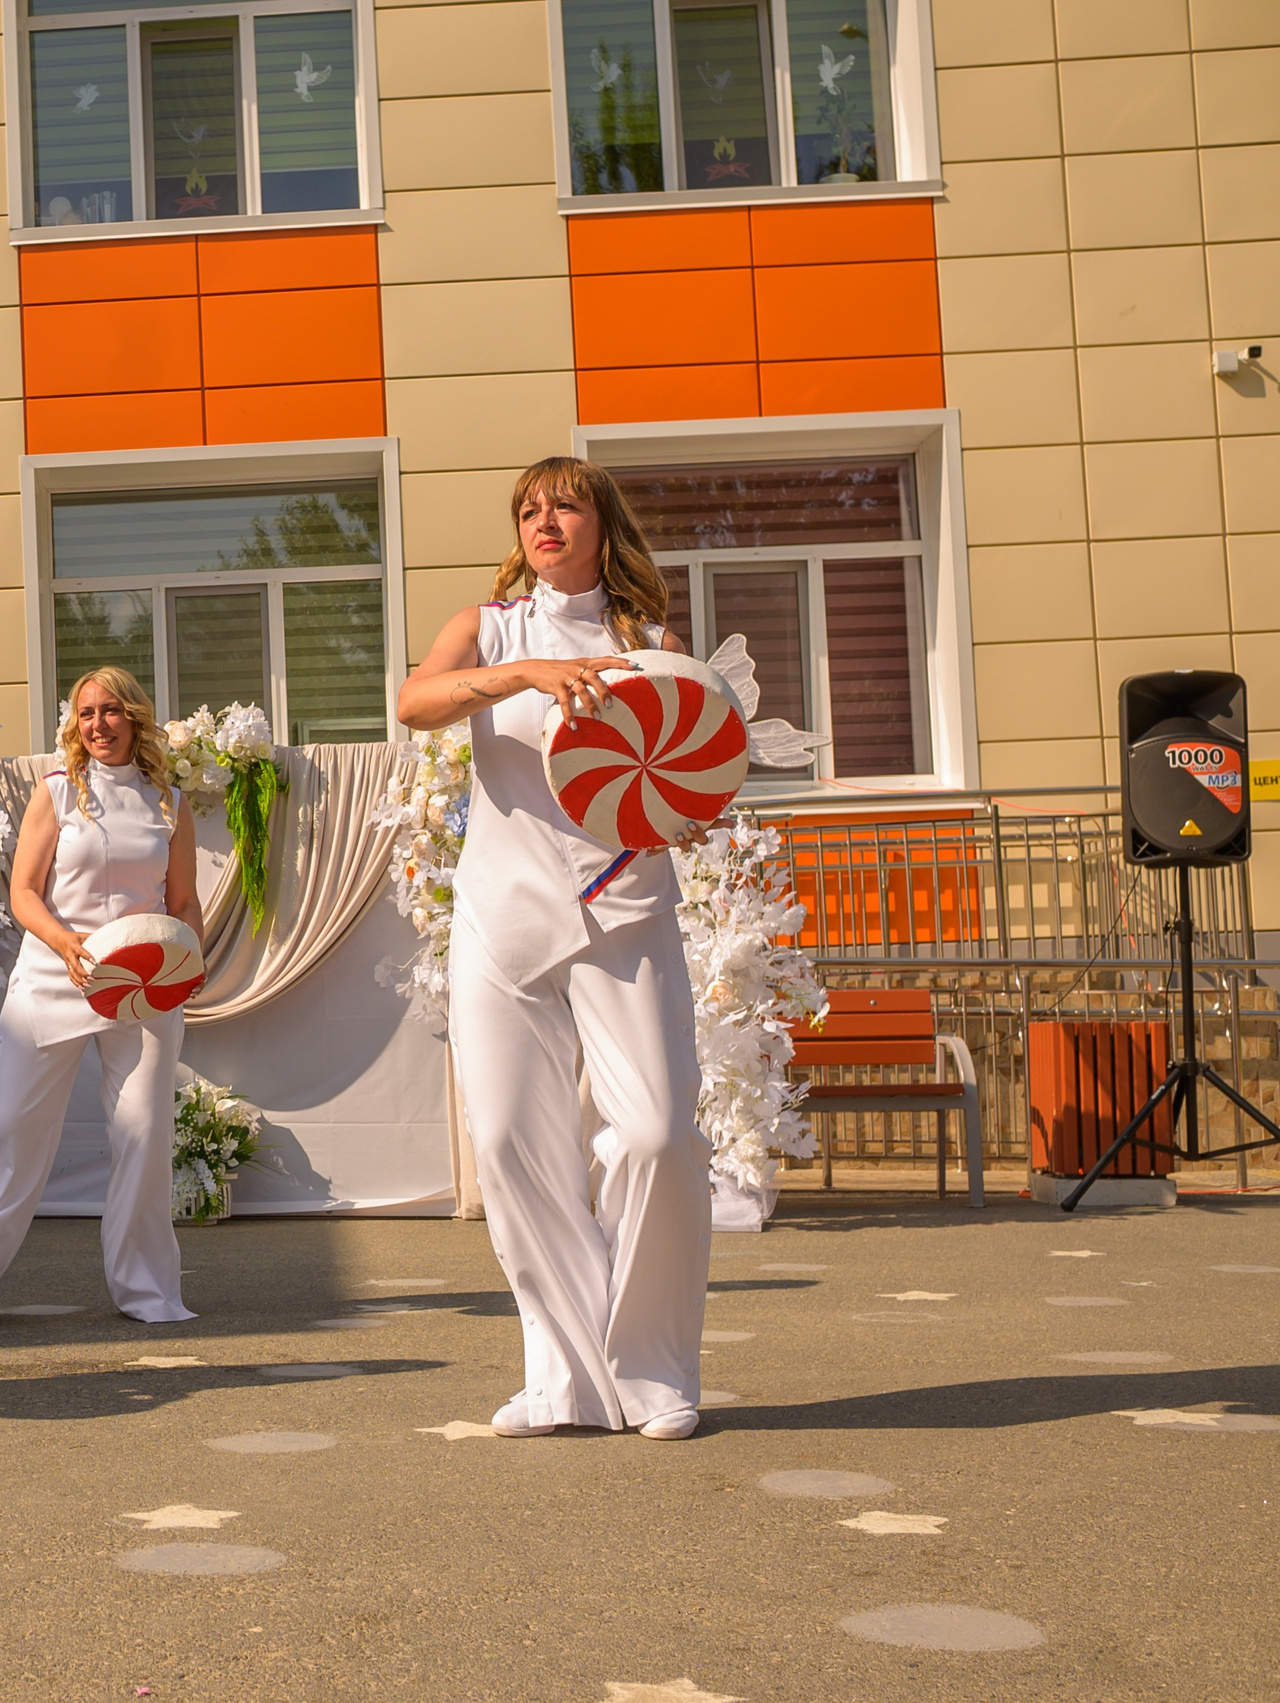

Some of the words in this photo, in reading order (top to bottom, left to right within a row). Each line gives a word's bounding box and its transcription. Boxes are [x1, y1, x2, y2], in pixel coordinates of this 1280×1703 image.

[1165, 748, 1224, 767] 1000
[1208, 774, 1237, 786] MP3
[1253, 775, 1280, 787] ЦЕН
